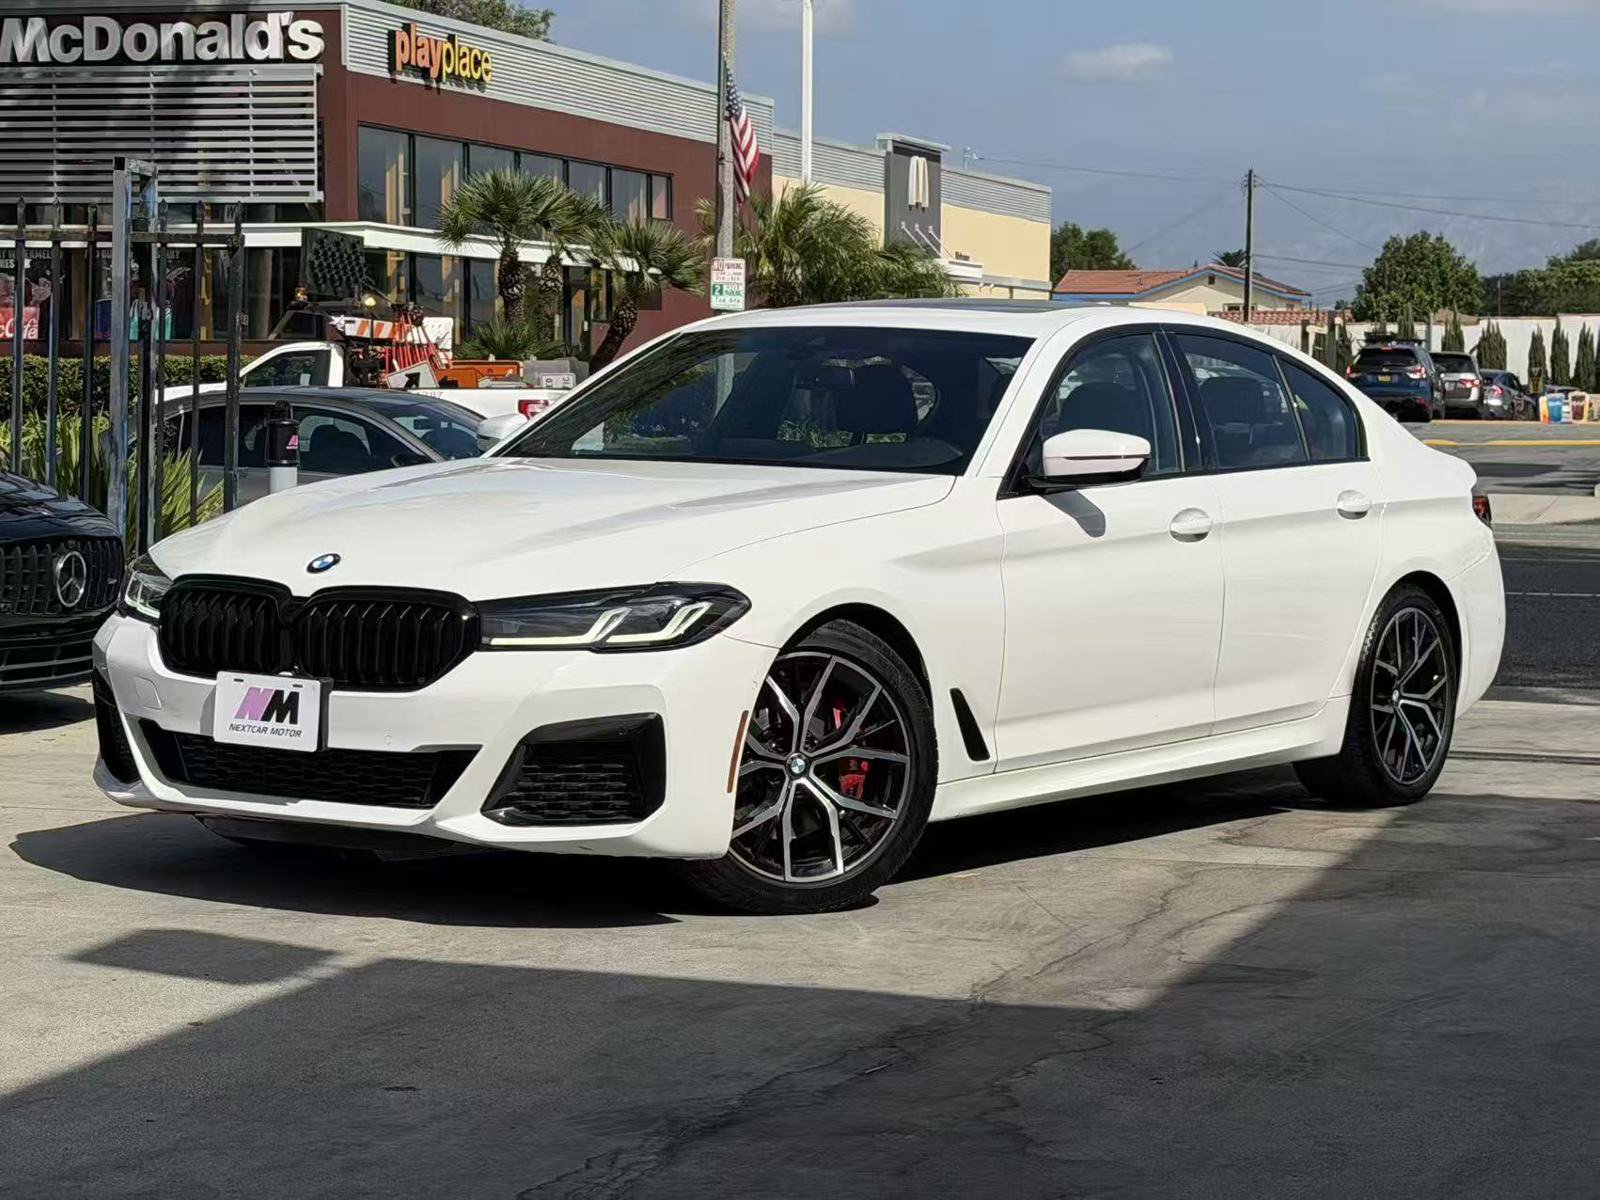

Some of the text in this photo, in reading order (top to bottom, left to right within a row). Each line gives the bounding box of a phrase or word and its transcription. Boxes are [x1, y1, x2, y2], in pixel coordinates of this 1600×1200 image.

[0, 11, 325, 63] McDonald's
[395, 22, 492, 83] playplace
[713, 284, 722, 296] 2
[228, 723, 302, 738] NEXTCAR MOTOR
